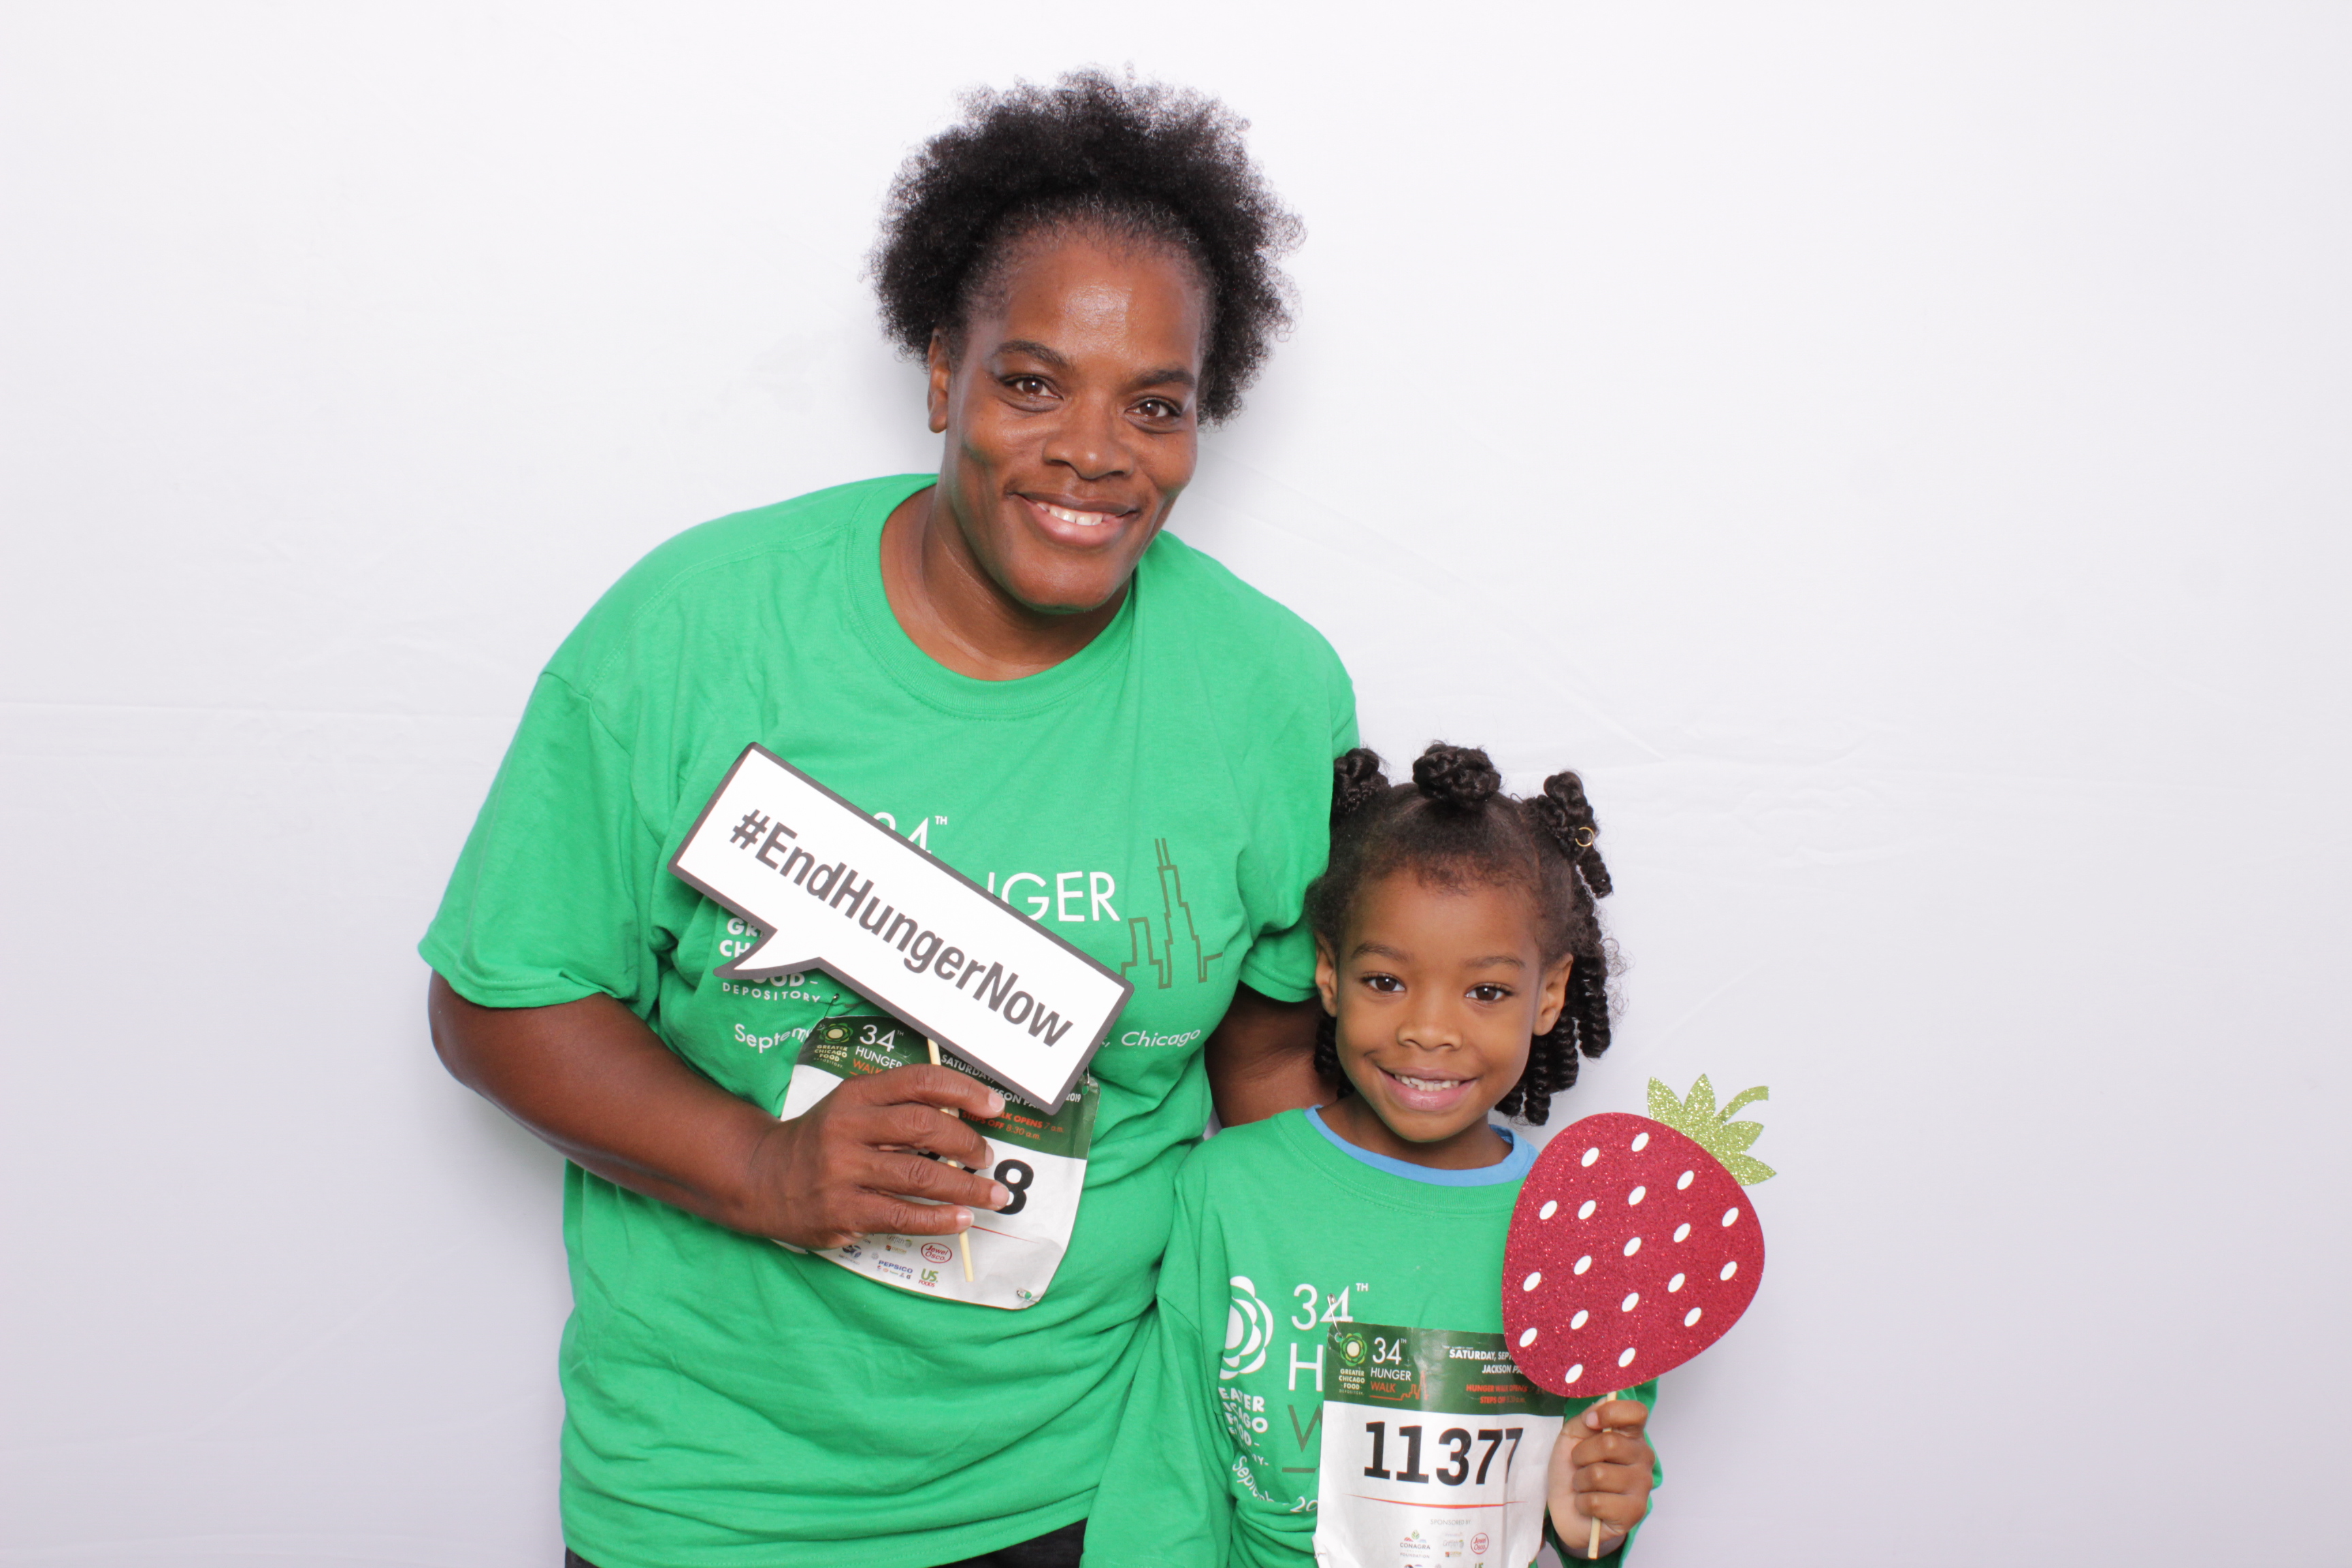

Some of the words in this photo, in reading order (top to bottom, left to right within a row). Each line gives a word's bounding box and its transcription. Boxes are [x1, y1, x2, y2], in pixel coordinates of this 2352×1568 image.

[729, 809, 1073, 1047] #EndHungerNow
[723, 982, 821, 1002] DEPOSITORY
[735, 1024, 812, 1054] Septem
[1121, 1029, 1201, 1047] Chicago
[814, 1049, 848, 1058] CHICAGO
[819, 1054, 840, 1062] FOOD
[1066, 1092, 1081, 1103] 2019
[962, 1111, 986, 1124] STEPS
[988, 1120, 1004, 1129] OFF
[1006, 1125, 1026, 1136] 8:30
[1026, 1131, 1041, 1140] a.m.
[1013, 1115, 1043, 1128] OPENS
[926, 1245, 948, 1256] Jewel
[878, 1260, 913, 1273] PEPSICO
[919, 1279, 936, 1288] FOODS
[1449, 1349, 1497, 1361] SATURDAY,
[1340, 1368, 1365, 1377] GREATER
[1371, 1367, 1411, 1382] HUNGER
[1482, 1365, 1512, 1373] JACKSON
[1339, 1375, 1365, 1384] CHICAGO
[1371, 1382, 1397, 1392] WALK
[1466, 1384, 1494, 1392] HUNGER
[1480, 1396, 1497, 1404] STEPS
[1363, 1420, 1524, 1486] 11377
